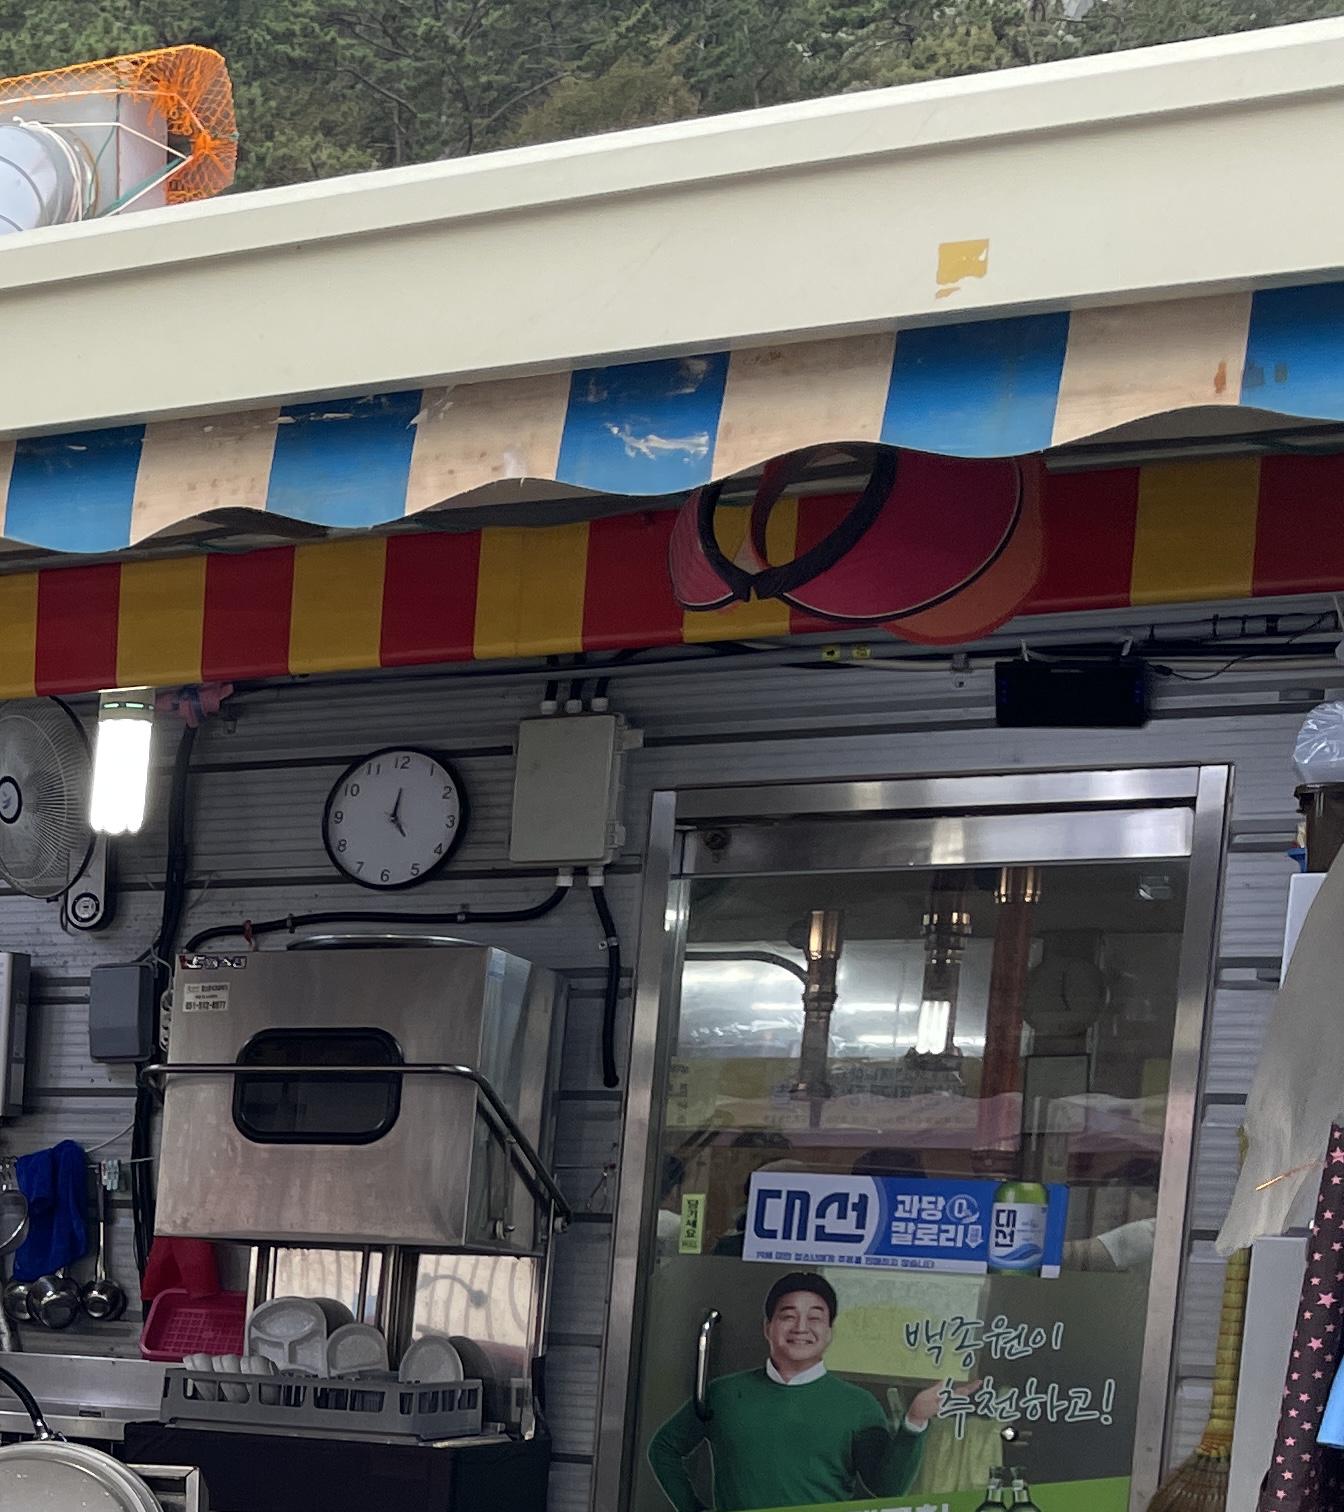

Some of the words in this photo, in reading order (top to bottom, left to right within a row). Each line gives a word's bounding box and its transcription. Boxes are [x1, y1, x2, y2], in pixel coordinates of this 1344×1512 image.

[366, 762, 382, 777] 11
[394, 755, 411, 770] 12
[429, 763, 436, 777] 1
[344, 783, 361, 797] 10
[442, 785, 453, 800] 2
[334, 811, 344, 825] 9
[445, 814, 456, 829] 3
[337, 839, 348, 853] 8
[433, 842, 444, 856] 4
[355, 861, 365, 875] 7
[380, 868, 391, 883] 6
[410, 862, 421, 877] 5
[894, 1194, 946, 1221] 과당
[890, 1221, 965, 1248] 칼로리
[905, 1315, 1065, 1370] 백종원이
[938, 1375, 1116, 1440] 추천하고!
